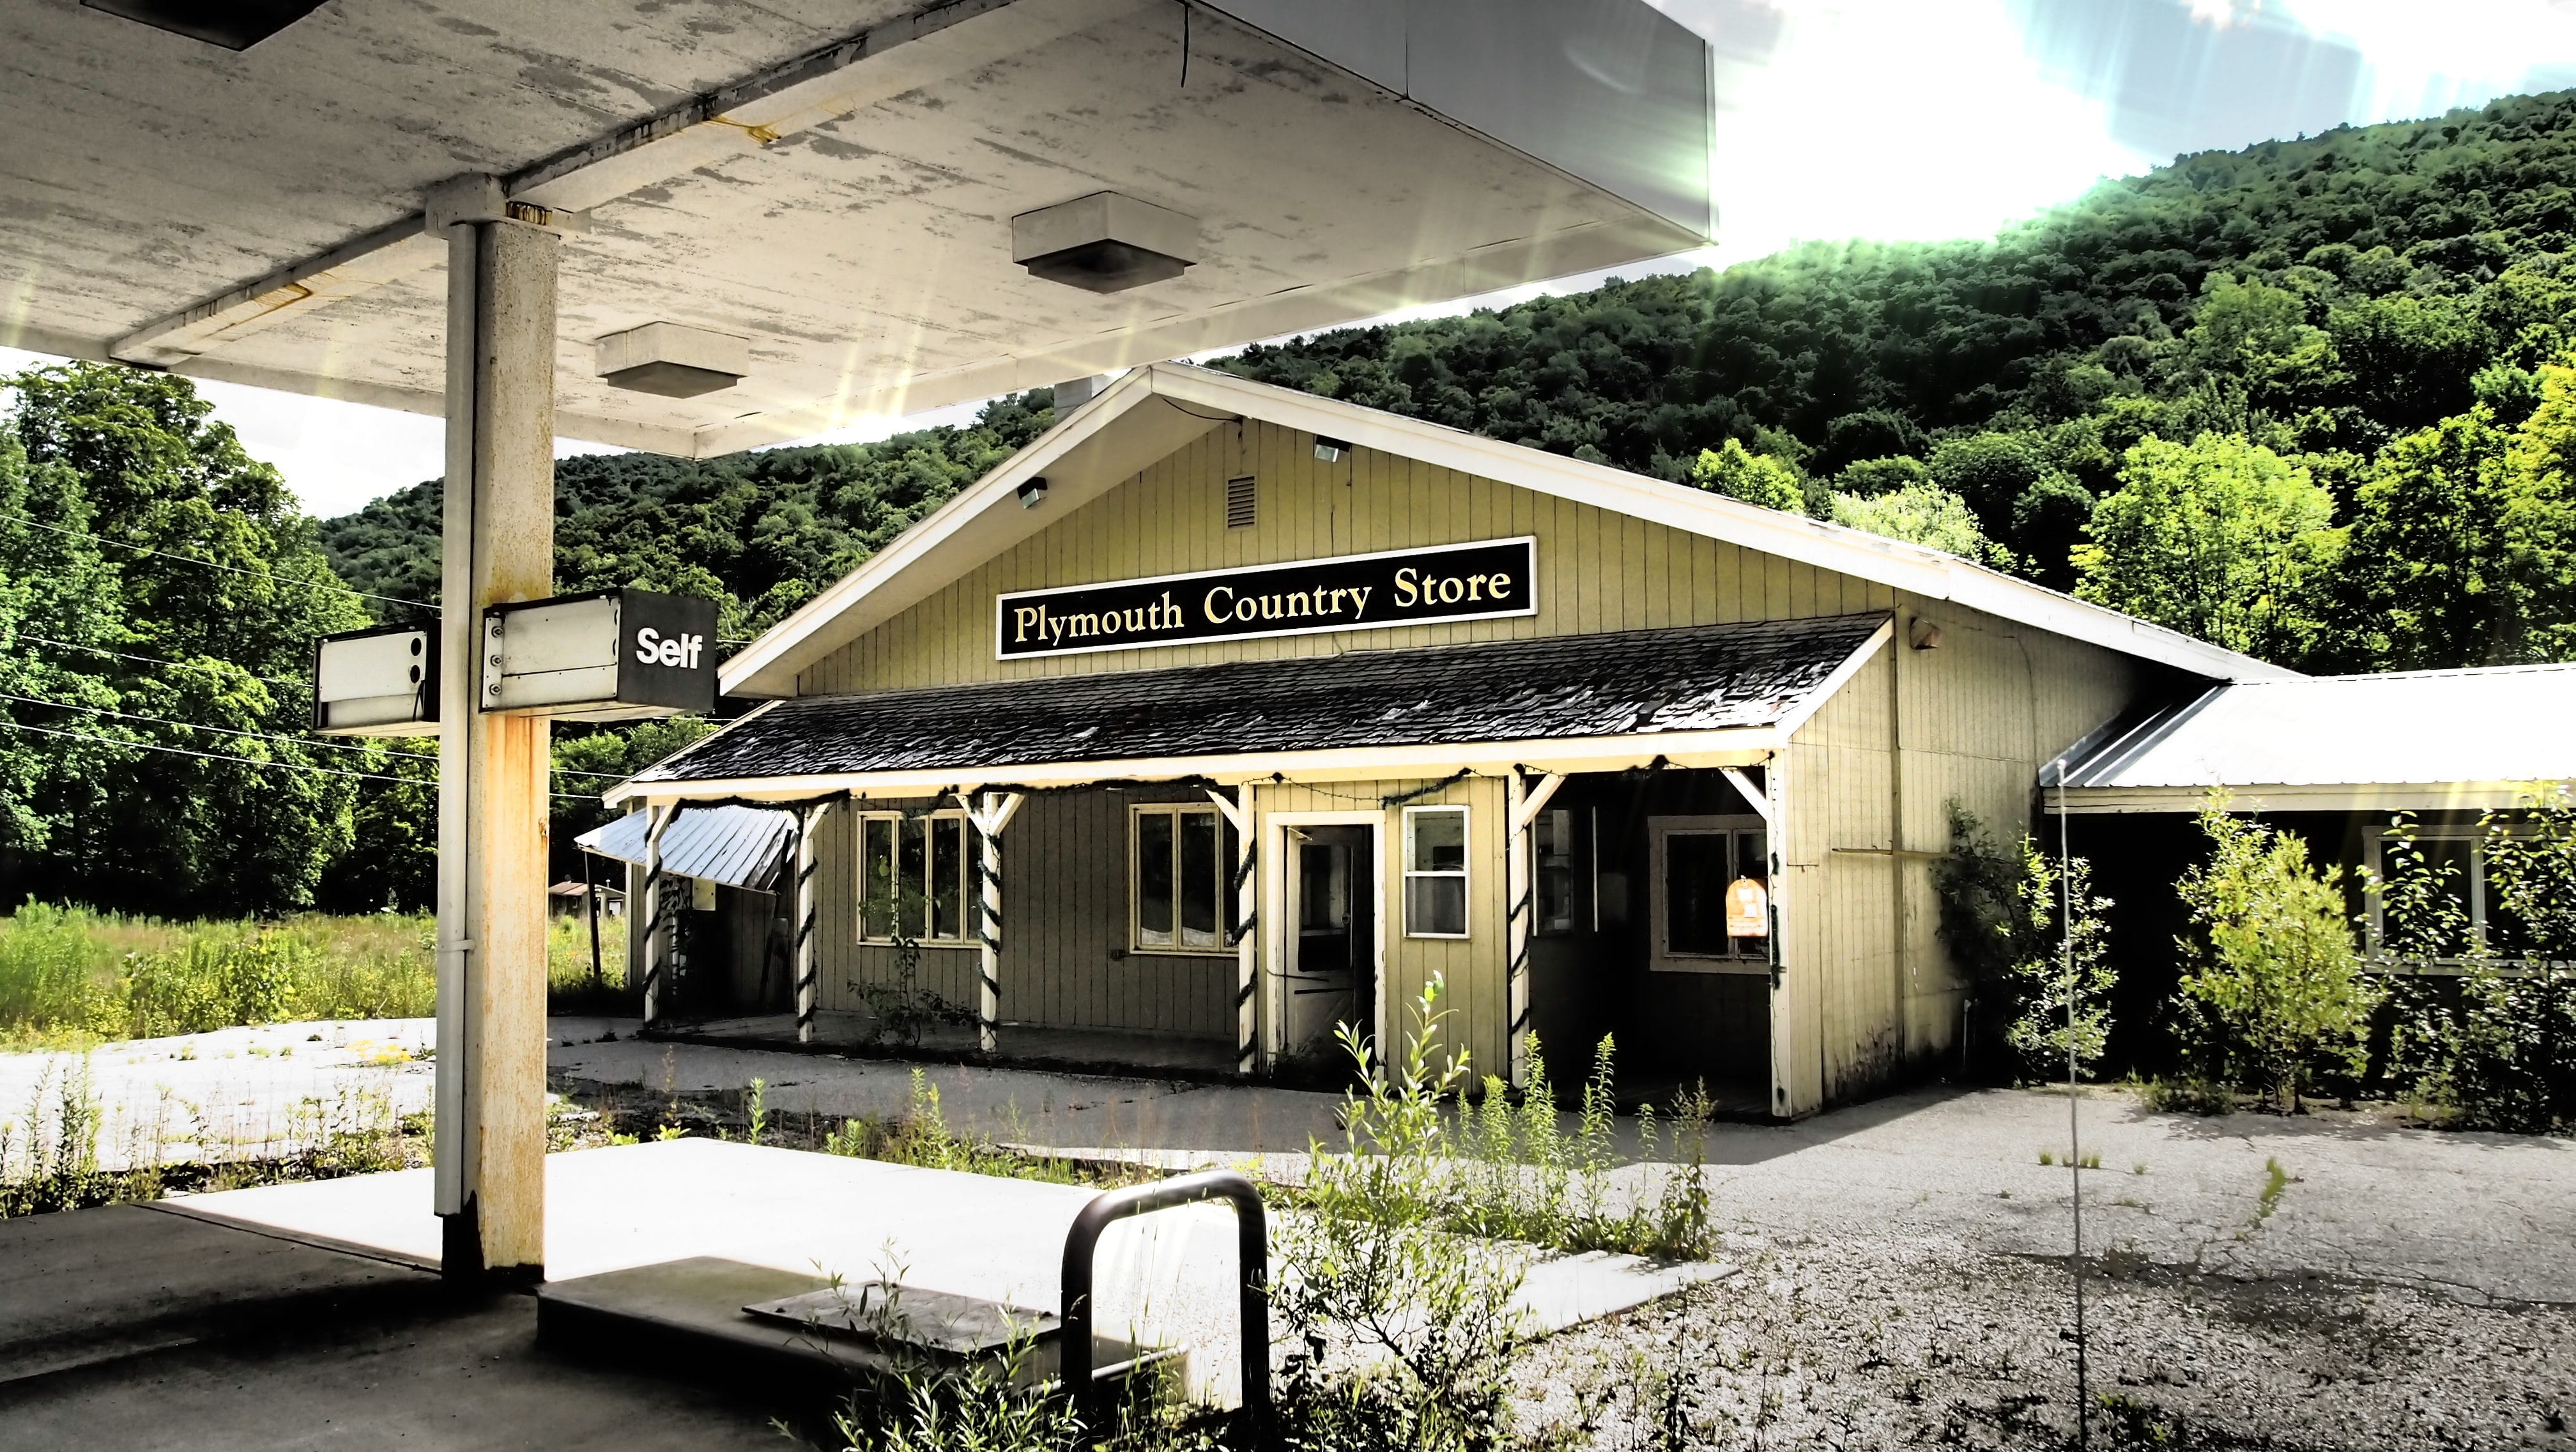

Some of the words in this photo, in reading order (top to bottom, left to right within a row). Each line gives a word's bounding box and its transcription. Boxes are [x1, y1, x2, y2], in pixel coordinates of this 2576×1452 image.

[1013, 590, 1184, 647] Plymouth
[1204, 585, 1373, 624] Country
[1393, 567, 1512, 608] Store
[636, 627, 703, 670] Self
